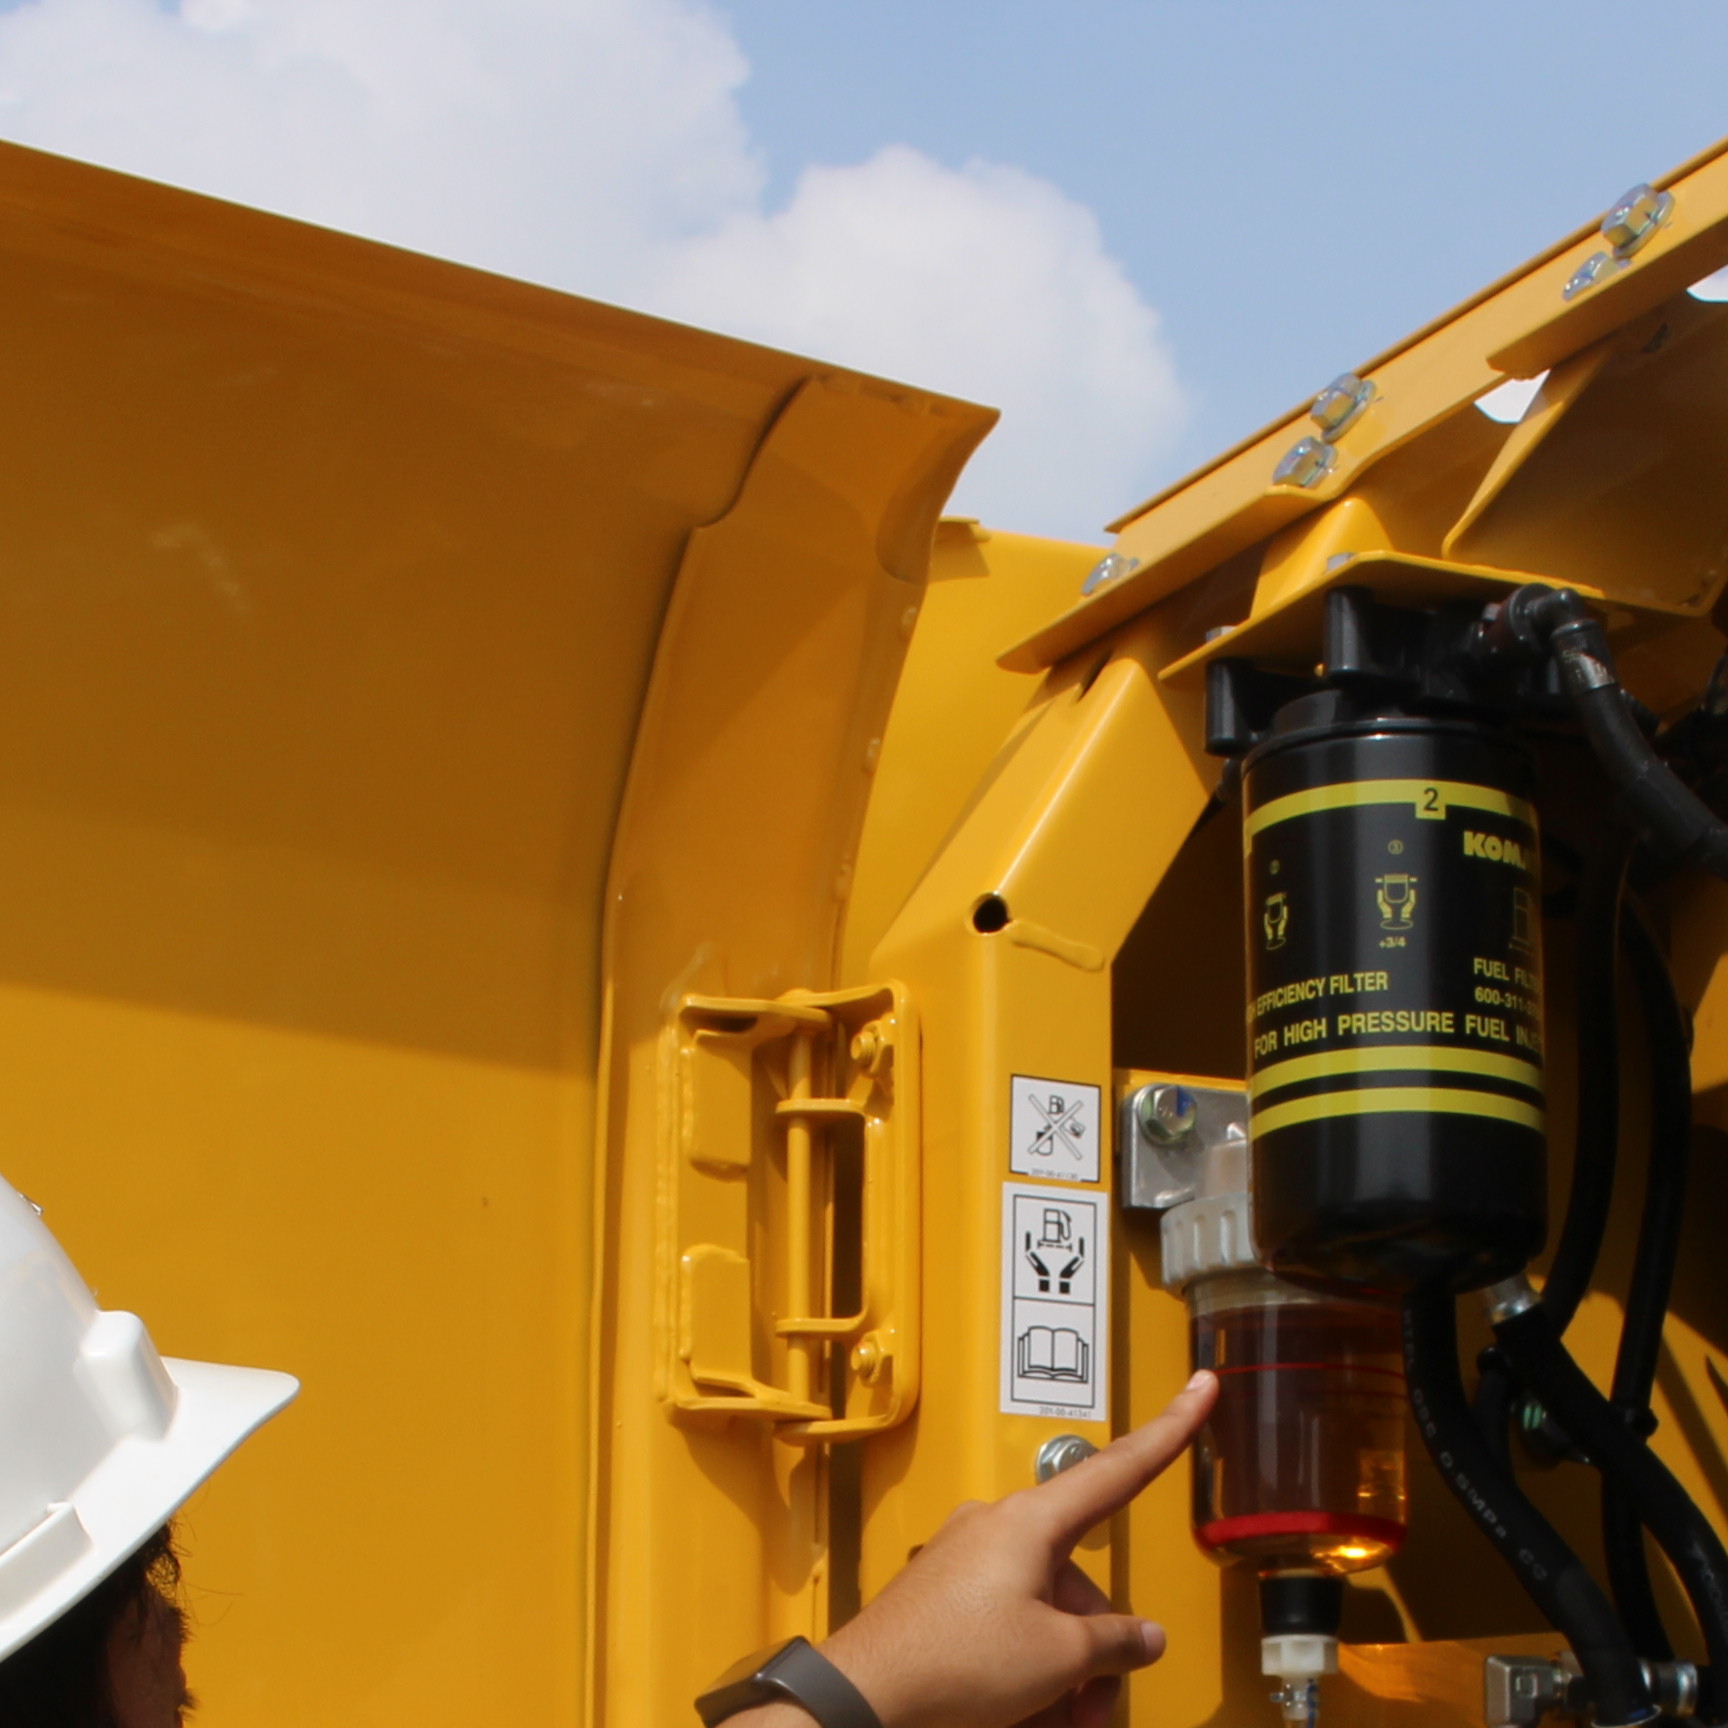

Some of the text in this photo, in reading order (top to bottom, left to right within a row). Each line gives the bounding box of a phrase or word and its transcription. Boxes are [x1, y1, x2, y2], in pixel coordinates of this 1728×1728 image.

[1423, 786, 1439, 812] 2
[1473, 957, 1510, 982] FUEL
[1256, 977, 1328, 1017] EFFICIENCY
[1329, 971, 1388, 995] FILTER
[1254, 1030, 1279, 1060] FOR
[1283, 1018, 1327, 1046] HIGH
[1336, 1010, 1455, 1037] PRESSURE
[1464, 1013, 1510, 1041] FUEL
